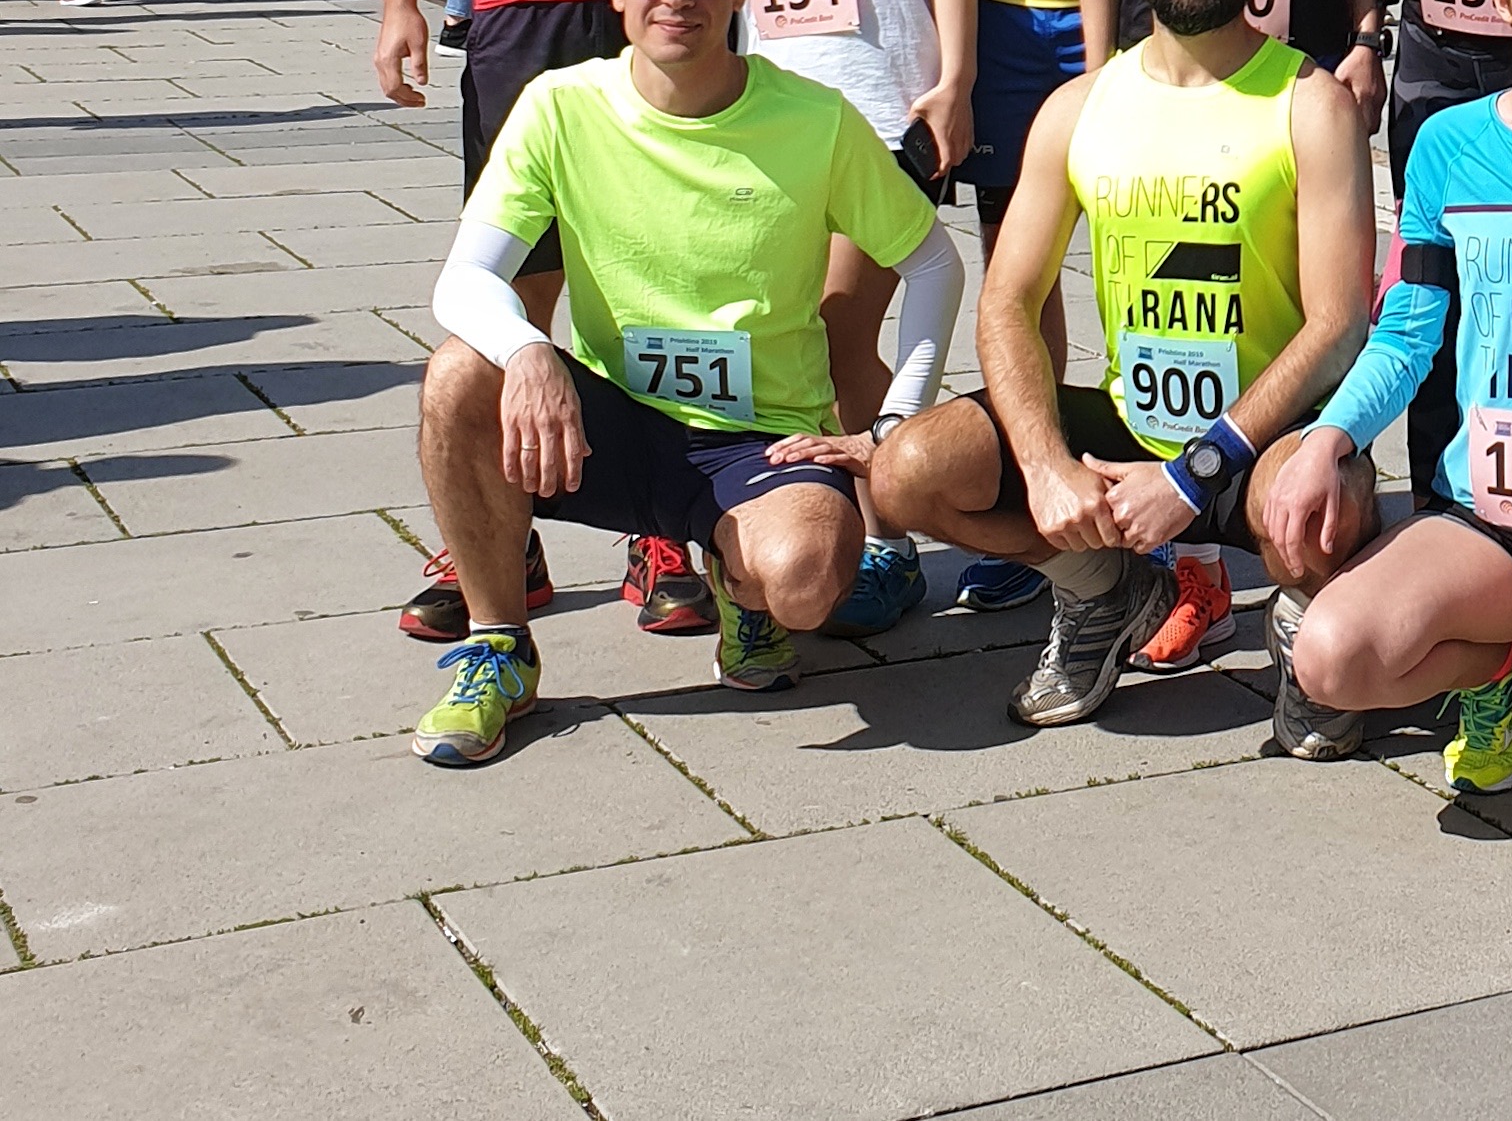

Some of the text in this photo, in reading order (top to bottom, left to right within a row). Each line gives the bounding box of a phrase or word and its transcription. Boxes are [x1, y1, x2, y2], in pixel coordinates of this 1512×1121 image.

[1096, 175, 1241, 224] RUNNERS
[1106, 234, 1137, 276] OF
[1108, 280, 1244, 334] TIRANA
[1471, 292, 1502, 338] OF
[638, 353, 738, 402] 751
[1132, 362, 1223, 420] 900
[1162, 421, 1209, 433] ProCredit Ban
